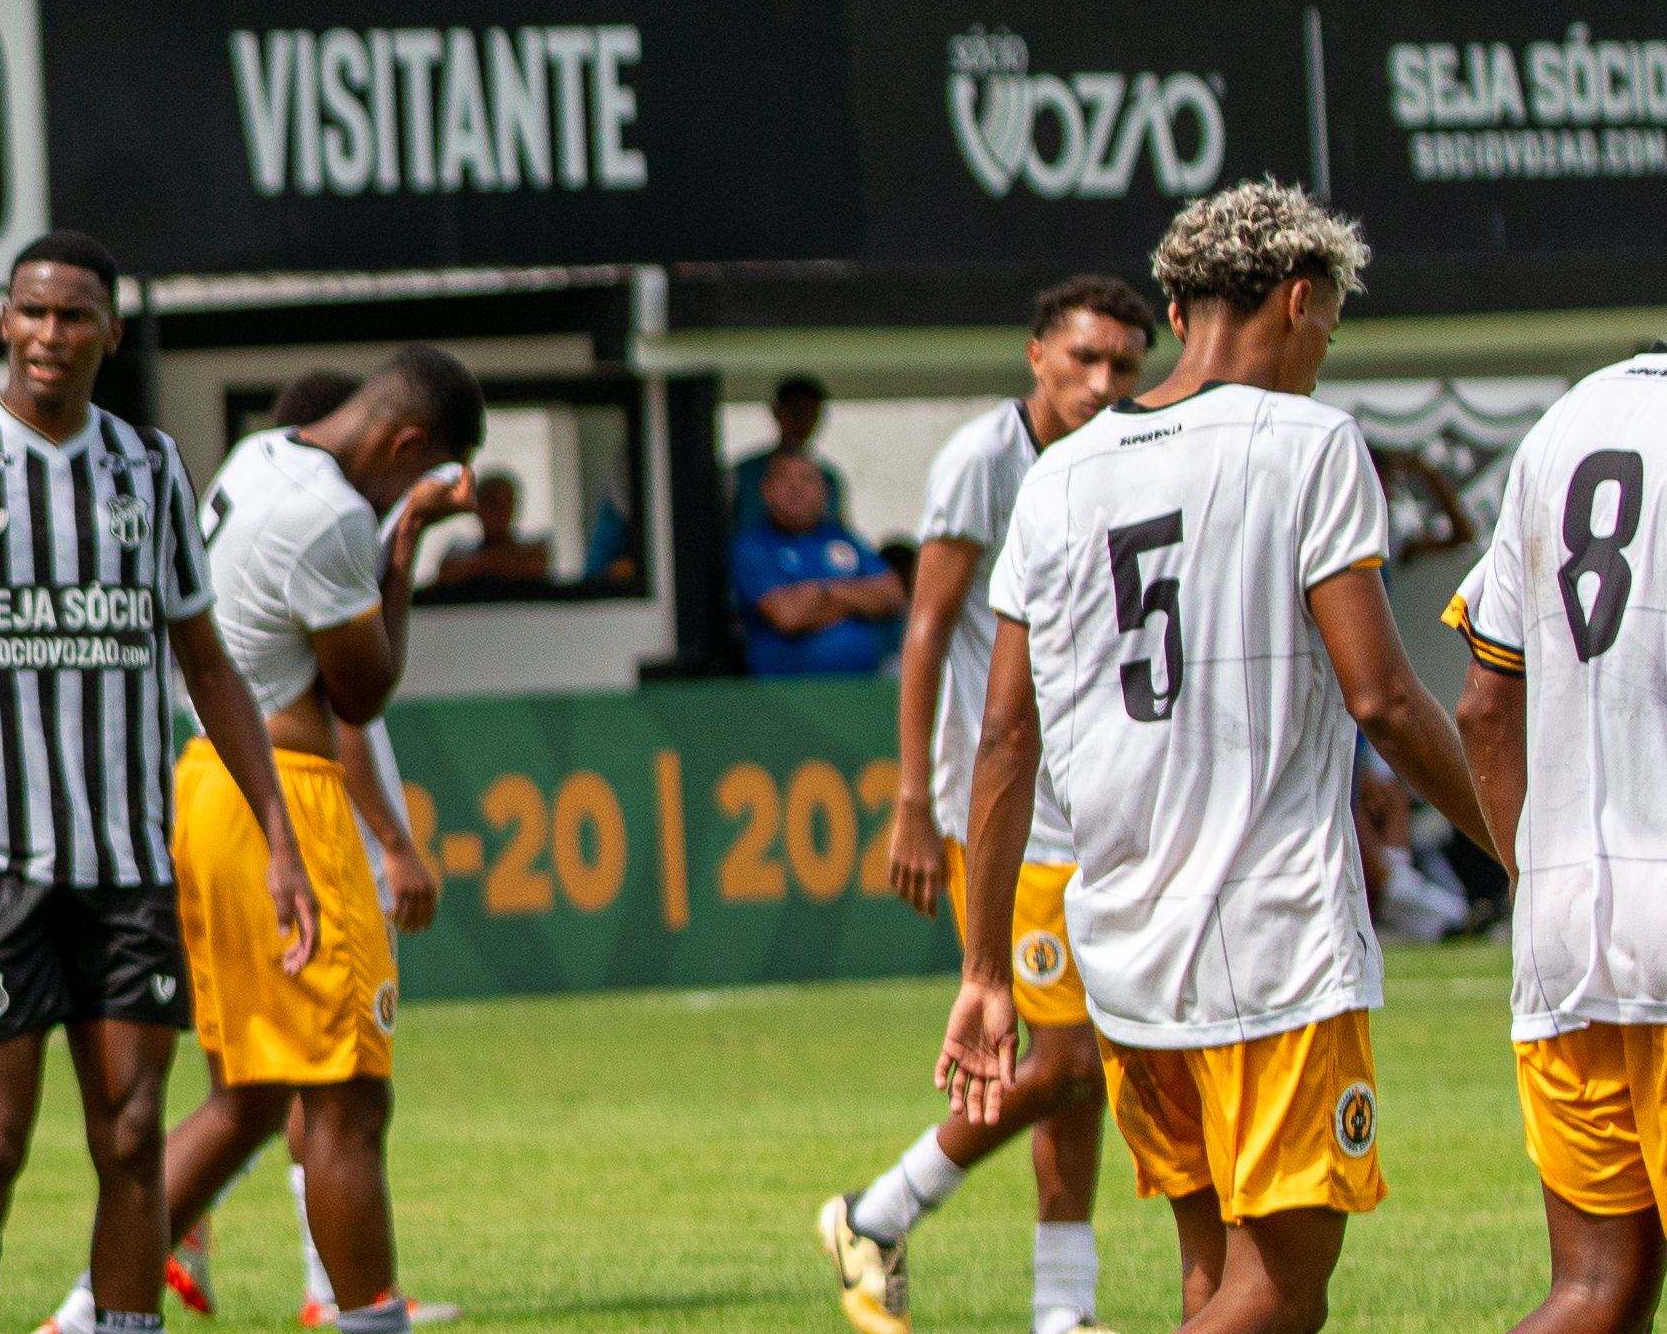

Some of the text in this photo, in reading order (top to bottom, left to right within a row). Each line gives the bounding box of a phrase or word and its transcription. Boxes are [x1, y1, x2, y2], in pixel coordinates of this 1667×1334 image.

[228, 24, 648, 197] VISITANTE
[1387, 21, 1667, 130] SEJA SÓCIO
[60, 578, 153, 631] SÓCIO
[1108, 507, 1183, 722] 5
[1557, 449, 1644, 664] 8
